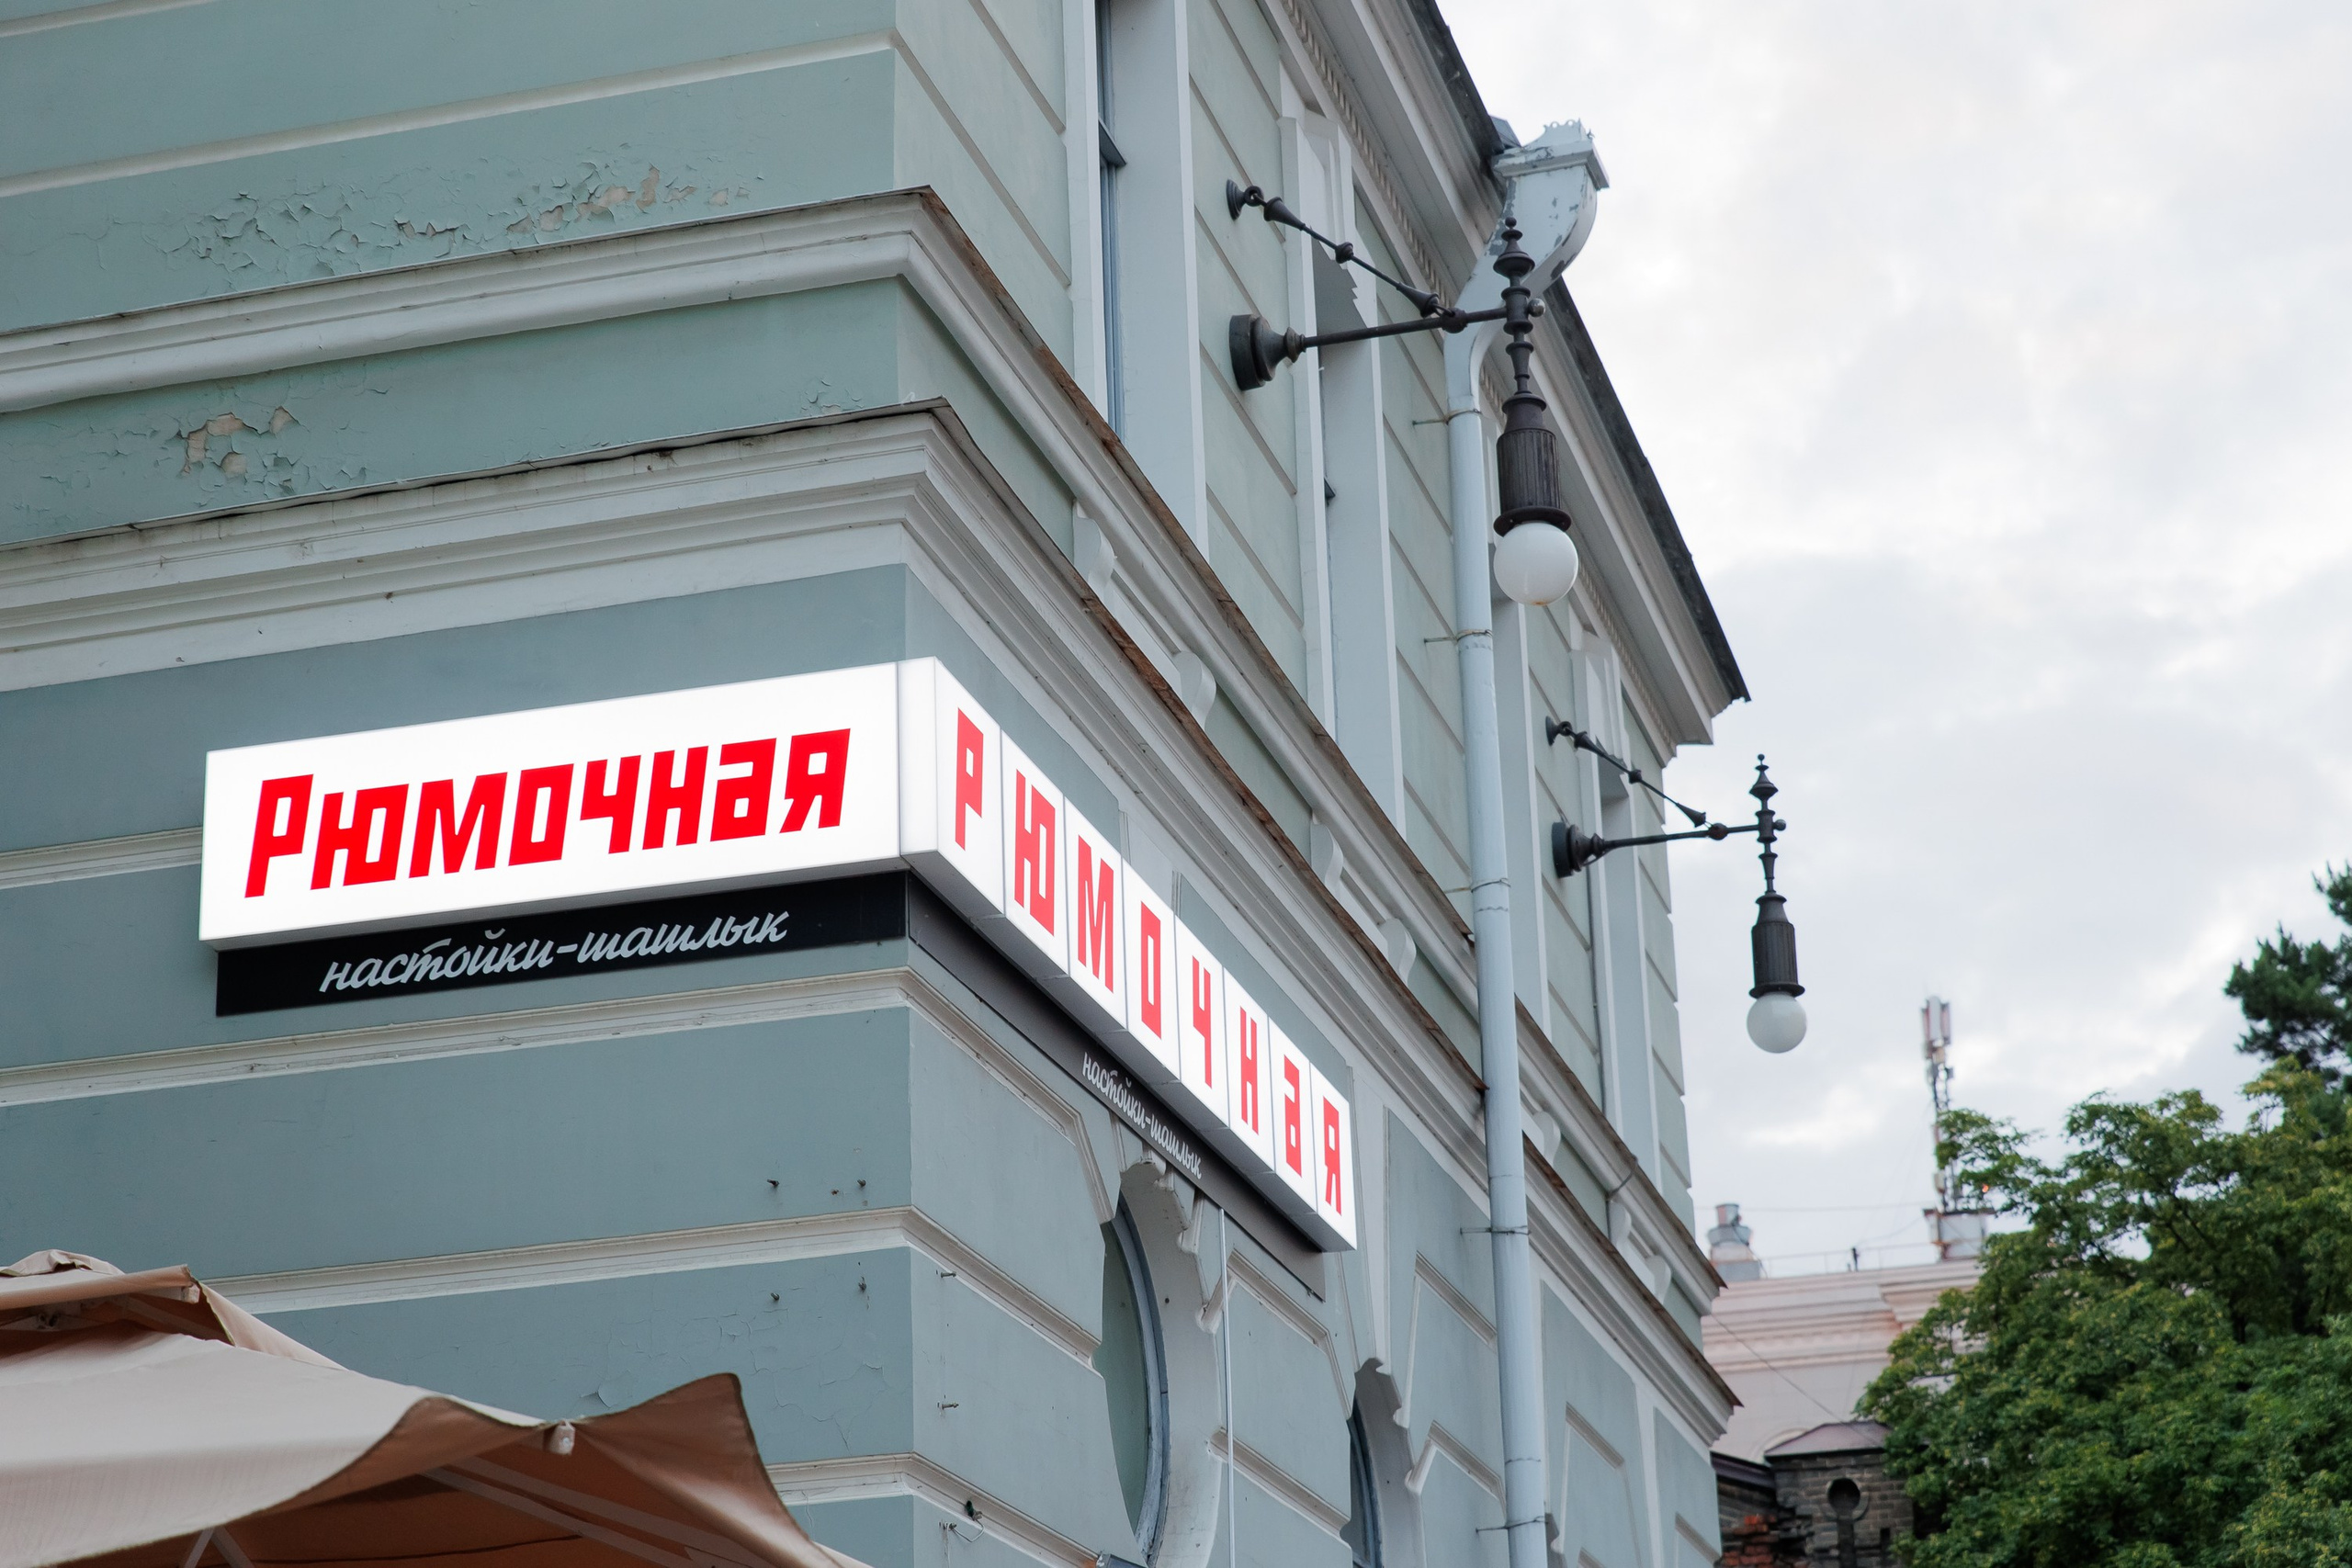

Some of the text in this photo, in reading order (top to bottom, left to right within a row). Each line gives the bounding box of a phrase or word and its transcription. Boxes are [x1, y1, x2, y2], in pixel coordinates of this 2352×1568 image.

[246, 728, 851, 897] Рюмочная
[319, 910, 789, 992] настойки-шашлык
[1082, 1051, 1202, 1179] настойки-шашлык
